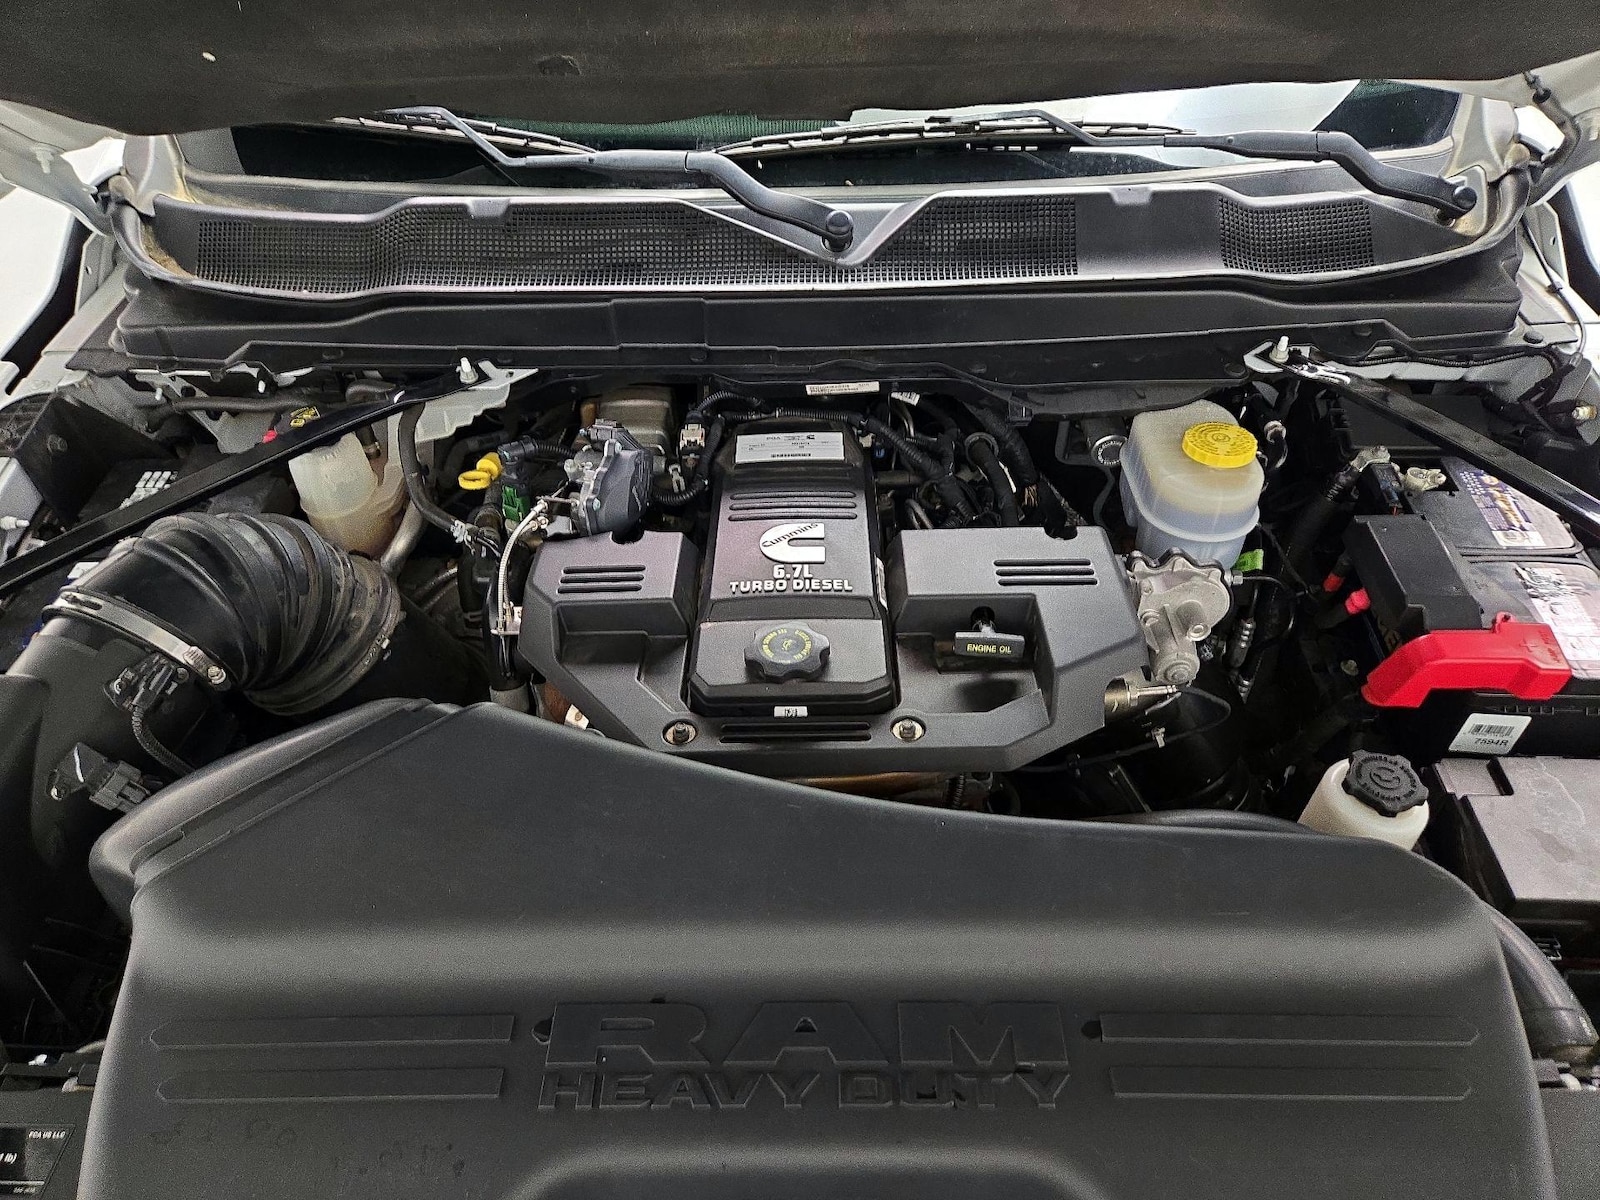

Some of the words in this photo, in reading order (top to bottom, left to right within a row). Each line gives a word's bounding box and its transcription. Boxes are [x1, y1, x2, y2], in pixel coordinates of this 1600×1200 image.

[762, 522, 818, 547] Cummins
[773, 564, 813, 579] 6.7L
[729, 580, 787, 594] TURBO
[792, 579, 853, 592] DIESEL
[966, 643, 997, 653] ENGINE
[999, 645, 1012, 654] OIL
[545, 1002, 1069, 1066] RAM
[537, 1071, 822, 1111] HEAVY
[838, 1071, 1071, 1111] DUTY
